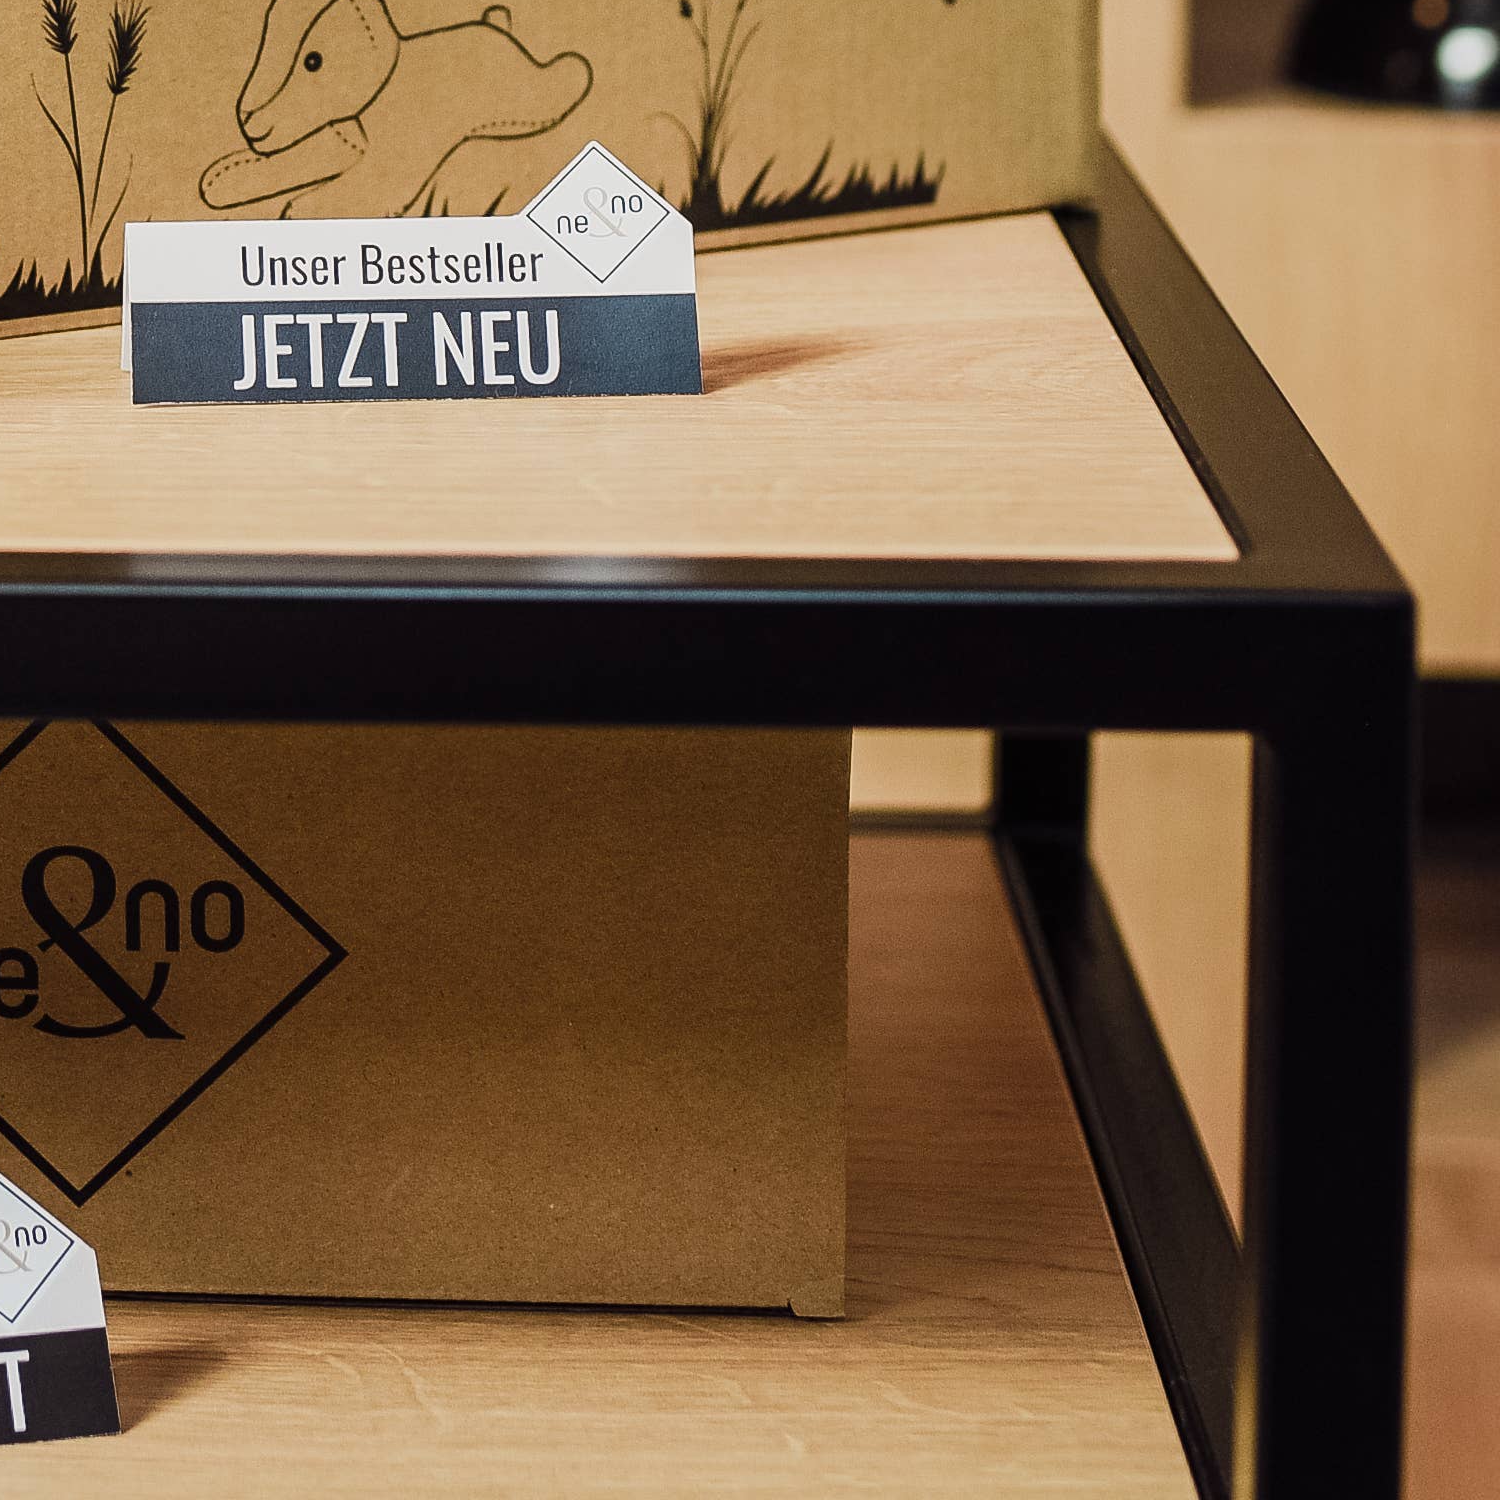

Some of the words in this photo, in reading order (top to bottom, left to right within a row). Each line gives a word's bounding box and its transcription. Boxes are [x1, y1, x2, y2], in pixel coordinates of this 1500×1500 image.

[240, 244, 347, 288] Unser
[361, 241, 545, 285] Bestseller
[232, 311, 409, 392] JETZT
[433, 308, 562, 387] NEU
